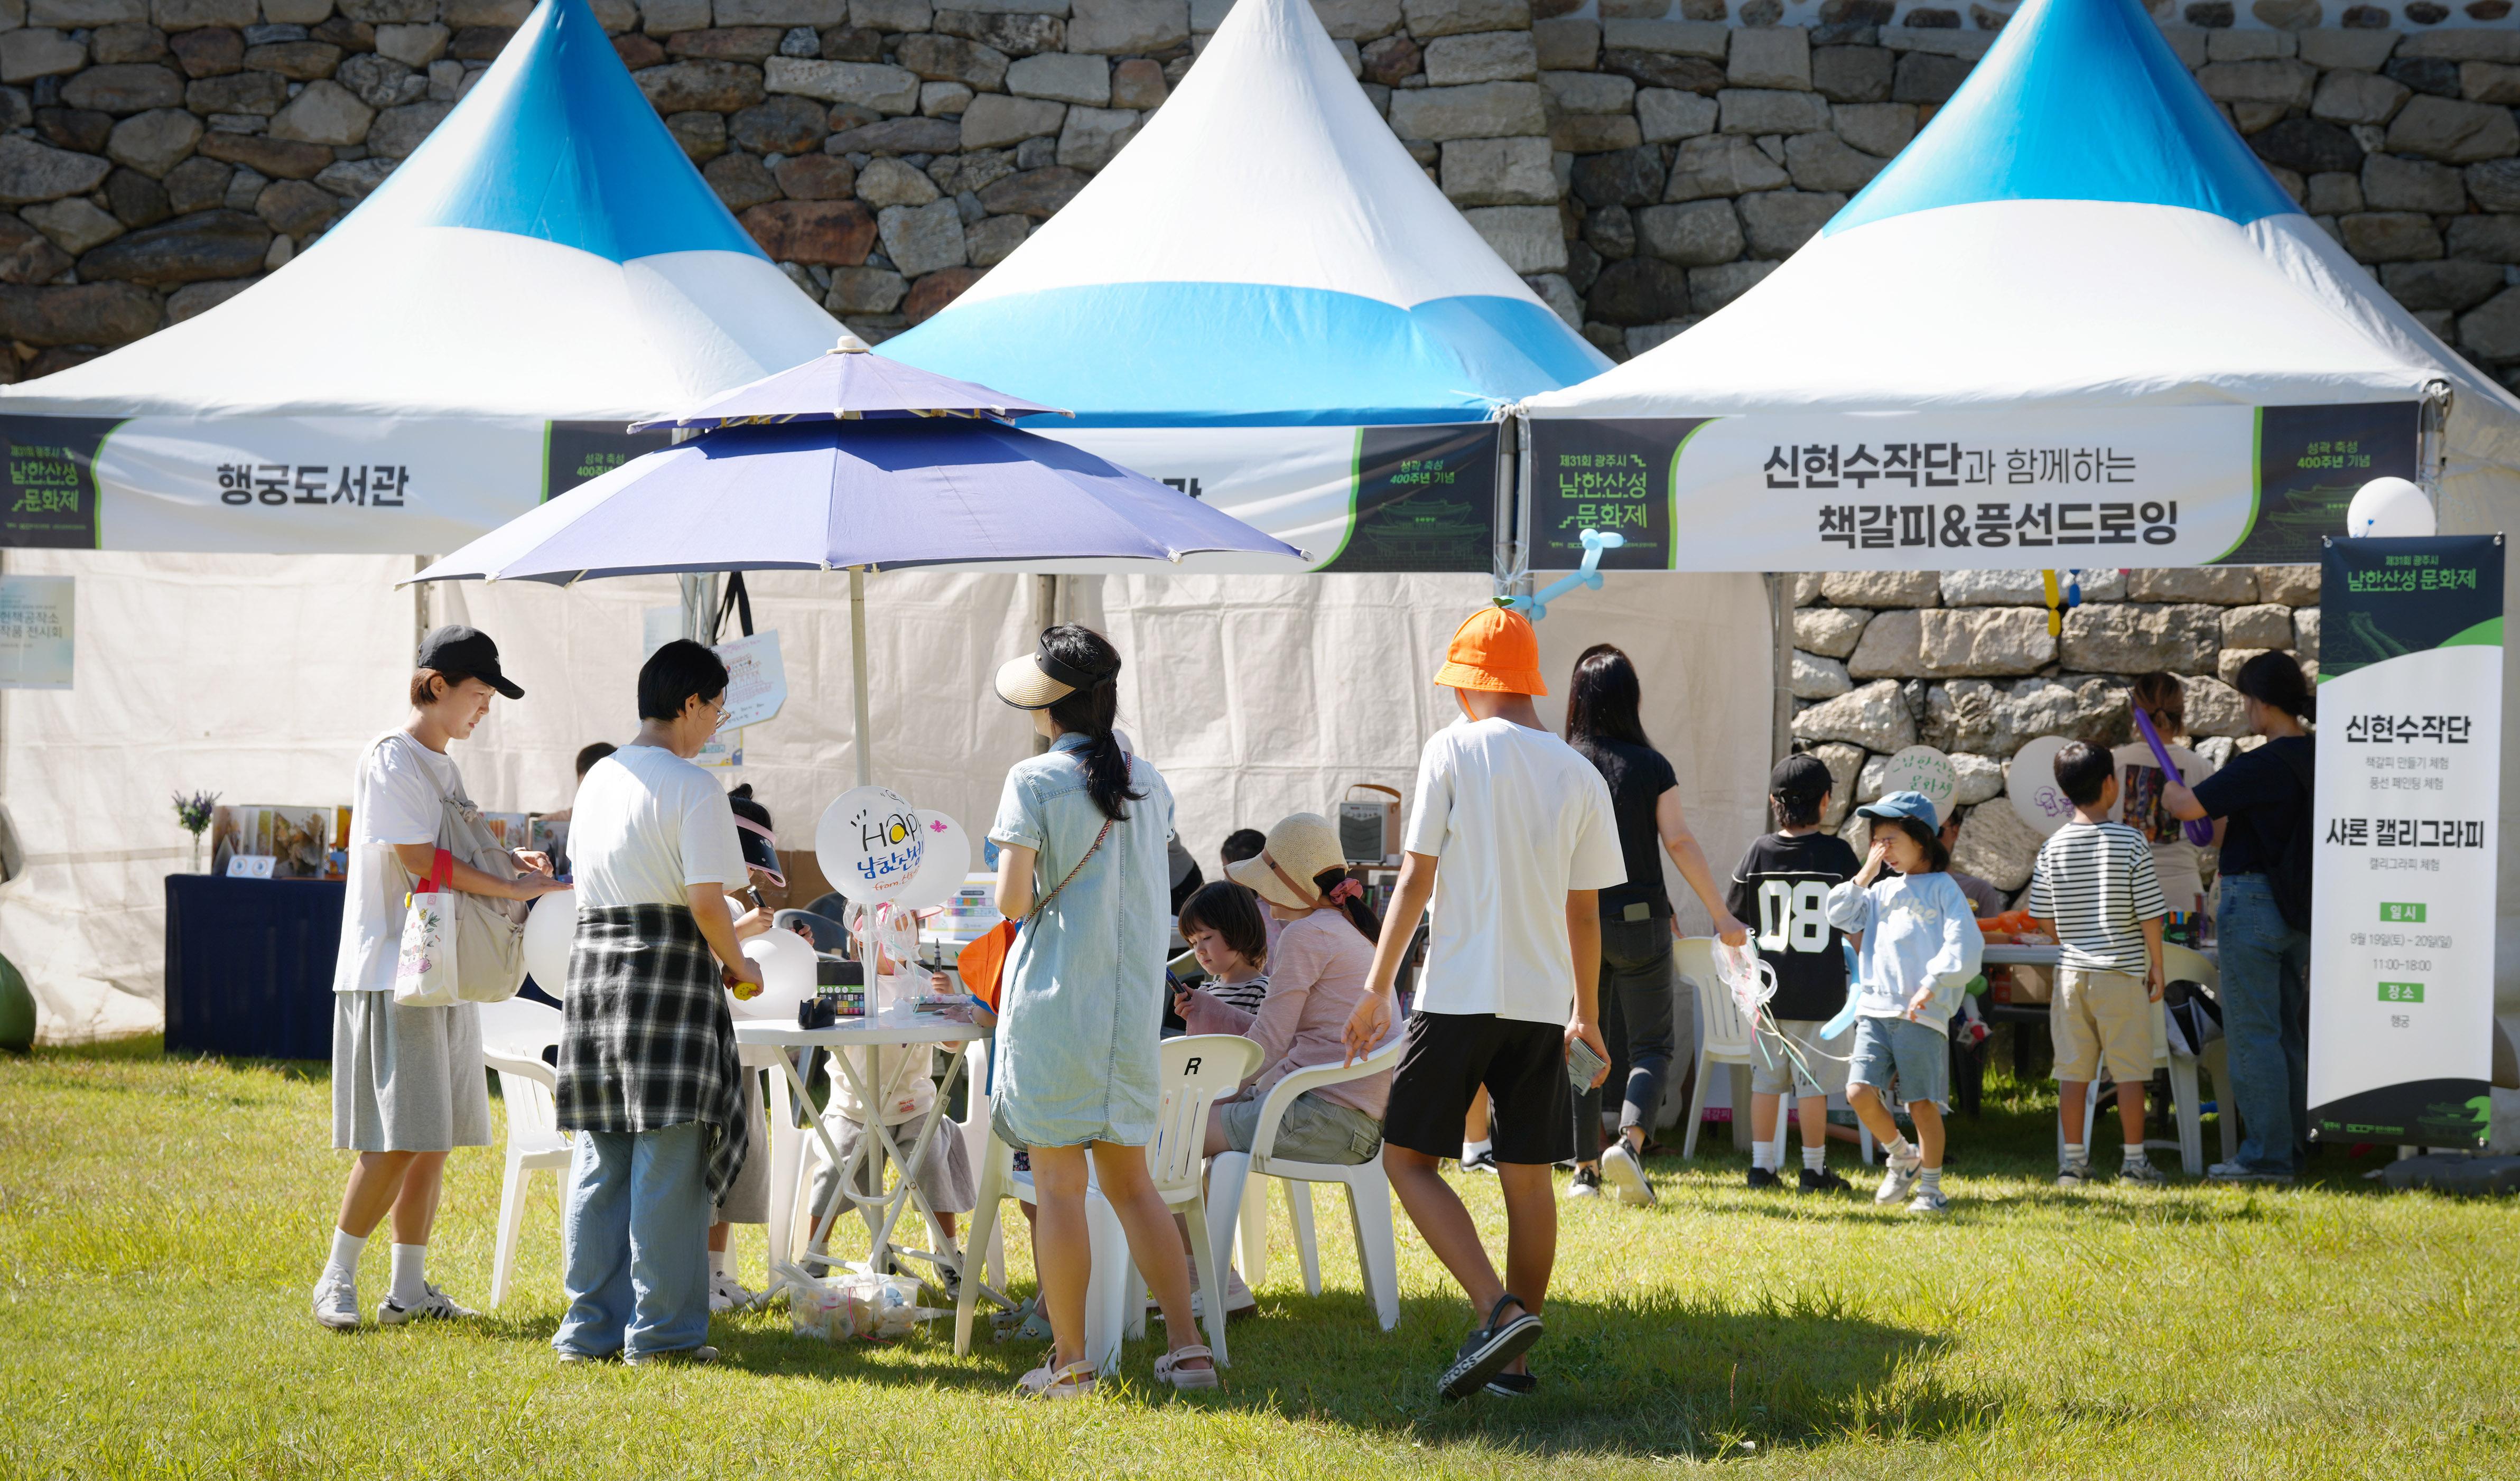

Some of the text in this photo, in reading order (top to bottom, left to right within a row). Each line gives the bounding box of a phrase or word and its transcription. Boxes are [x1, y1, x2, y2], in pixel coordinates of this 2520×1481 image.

[1559, 454, 1626, 467] 제31회 광주시
[1764, 443, 2136, 489] 신현수작단과 함께하는
[2297, 455, 2370, 468] 400주년 기념
[10, 460, 79, 486] 남한산성
[217, 463, 409, 506] 행궁도서관
[1390, 471, 1455, 484] 400주년 기념
[1559, 472, 1647, 498] 남한산성
[25, 489, 79, 513] 문화제
[1576, 503, 1648, 528] 문화제
[1818, 500, 2178, 549] 책갈피&풍선드로잉
[2413, 555, 2439, 566] 광주시
[2348, 568, 2476, 592] 남한산성 문화제
[2346, 715, 2471, 743] 신현수작단
[2366, 756, 2449, 770] 책갈피 만들기 체험
[2369, 776, 2444, 790] 풍선 페인팅 체험
[2326, 818, 2484, 849] 샤론 캘리그라피
[2420, 859, 2440, 872] 체험
[1758, 880, 1831, 953] 08
[2350, 933, 2366, 945] 9월
[2369, 934, 2405, 946] 19일(토)
[2414, 935, 2453, 948] 20일(일)
[2391, 1014, 2411, 1028] 행궁
[1184, 1057, 1202, 1075] R
